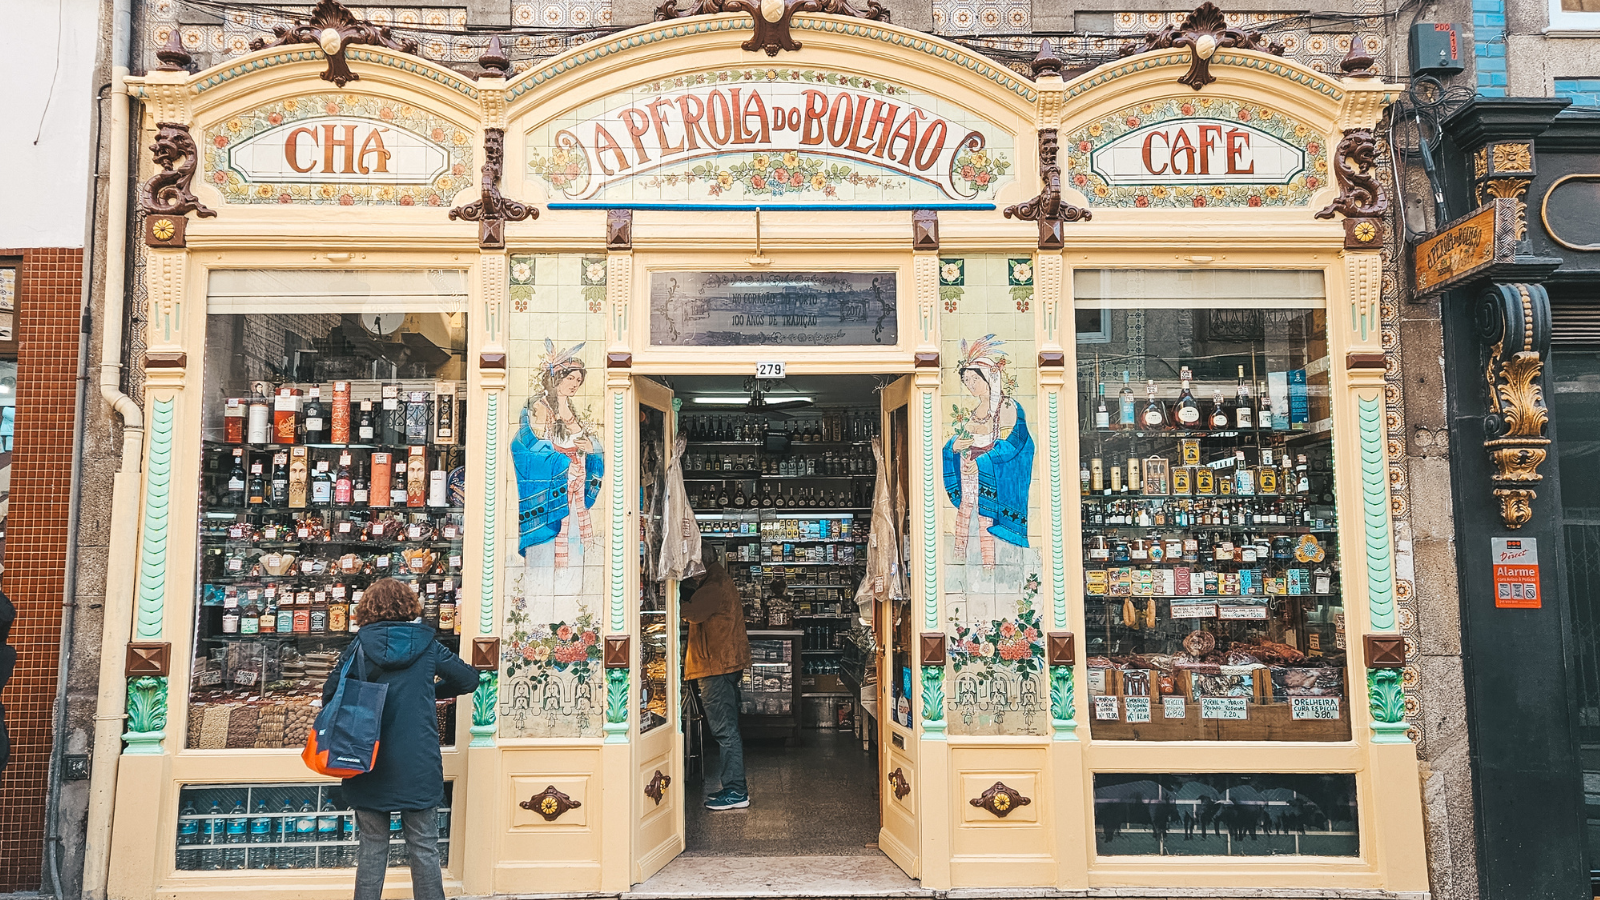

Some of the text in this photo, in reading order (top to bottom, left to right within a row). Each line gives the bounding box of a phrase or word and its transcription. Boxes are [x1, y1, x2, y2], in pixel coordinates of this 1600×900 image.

[593, 87, 947, 176] A PÉROLA DO BOLHÃO
[284, 123, 391, 175] CHÁ
[1141, 125, 1255, 175] CAFÉ
[732, 314, 818, 328] 100 ANOS DE TRADIÇÃO
[759, 364, 782, 375] 279
[1500, 549, 1529, 561] Direct
[1497, 566, 1535, 577] Alarme
[1294, 698, 1337, 706] ORELHEIRA
